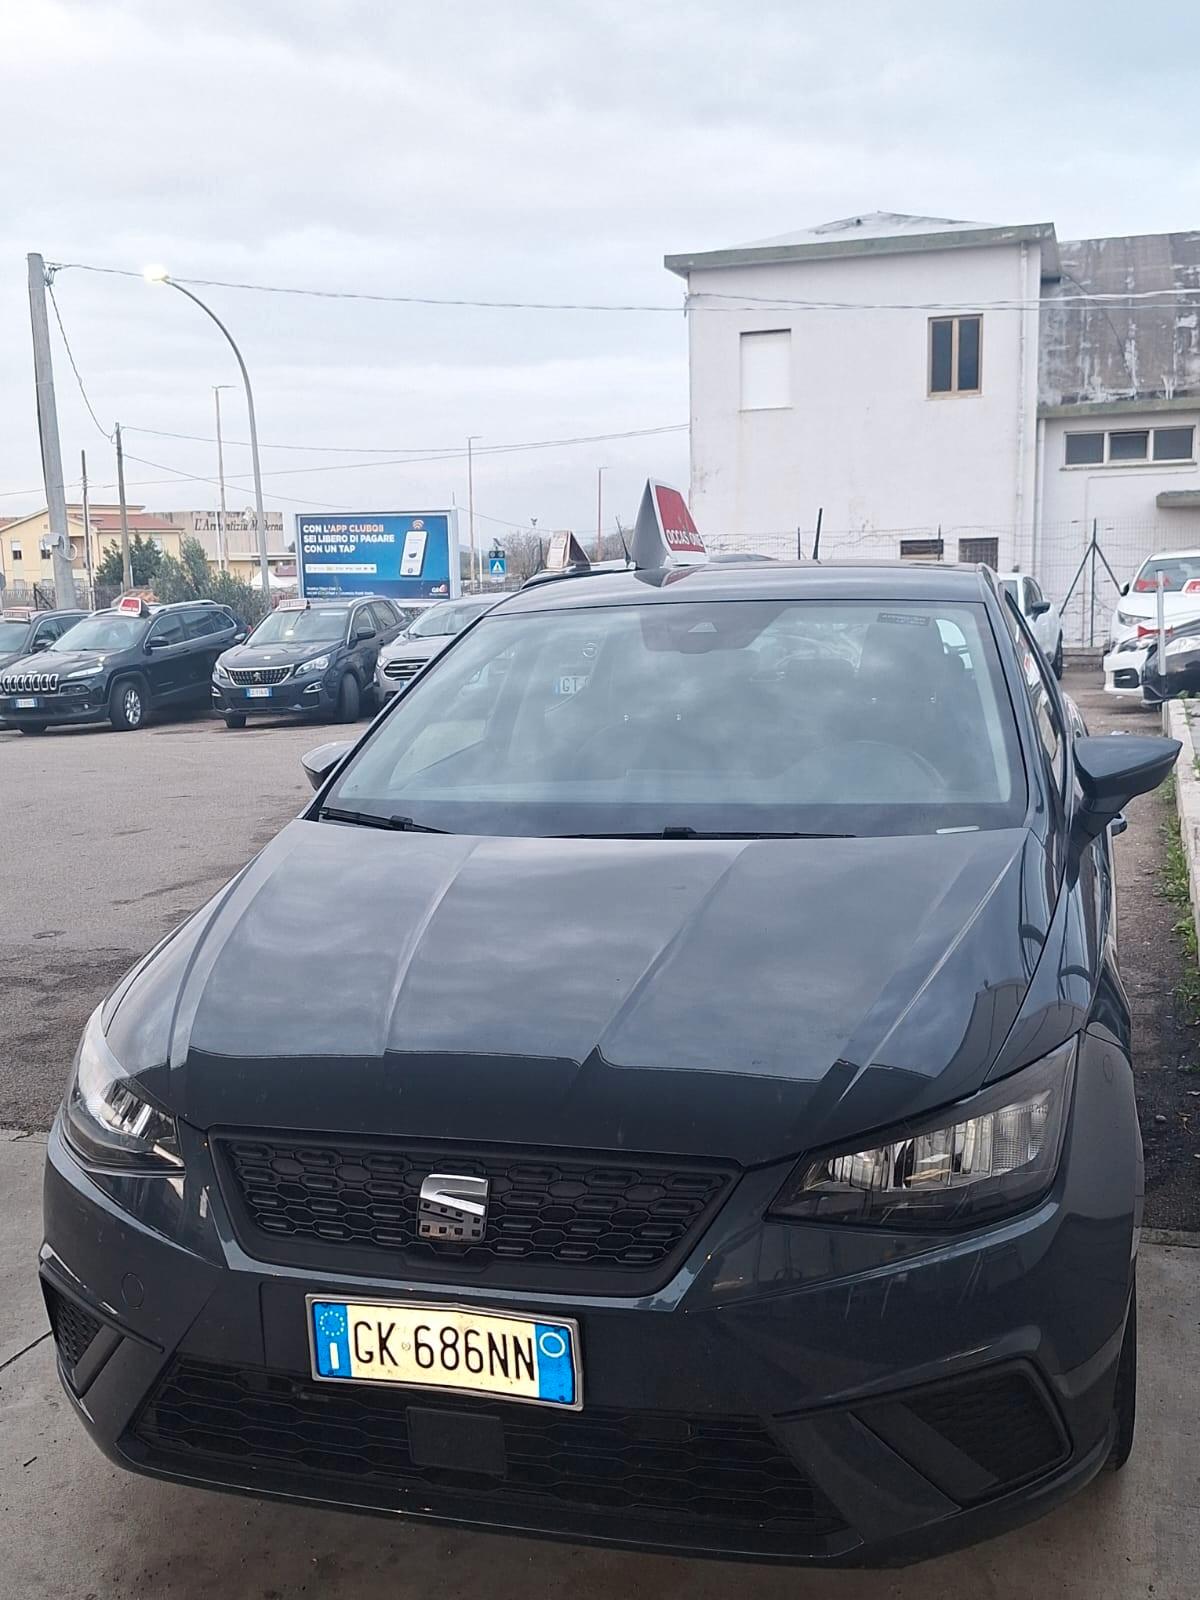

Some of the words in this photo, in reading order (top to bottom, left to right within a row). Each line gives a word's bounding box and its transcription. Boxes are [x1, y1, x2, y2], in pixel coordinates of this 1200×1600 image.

[303, 524, 322, 533] CON
[323, 524, 347, 533] L'APP
[303, 534, 317, 543] SEI
[318, 534, 348, 543] LIBERO
[350, 534, 358, 543] DI
[360, 534, 395, 543] PAGARE
[304, 544, 323, 553] CON
[324, 544, 337, 553] UN
[338, 544, 356, 553] TAP
[353, 1320, 398, 1367] GK
[414, 1325, 536, 1382] 686NN
